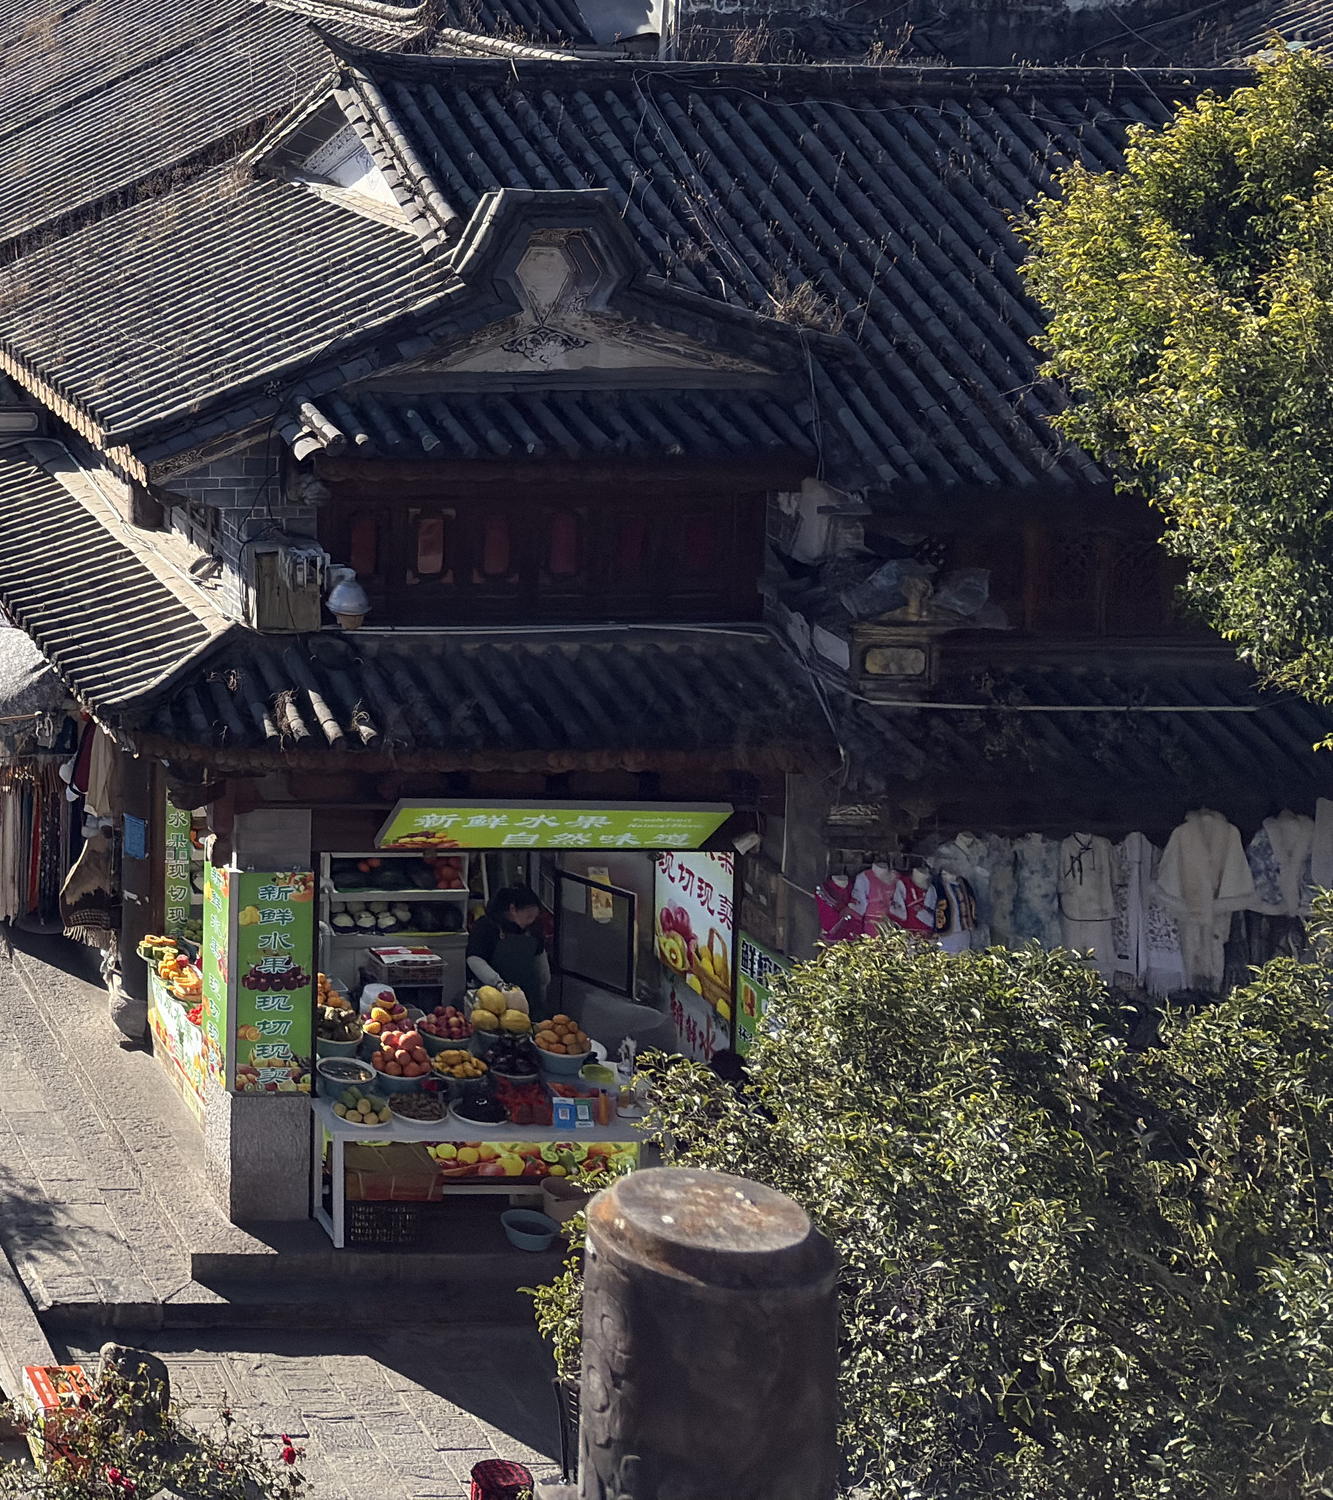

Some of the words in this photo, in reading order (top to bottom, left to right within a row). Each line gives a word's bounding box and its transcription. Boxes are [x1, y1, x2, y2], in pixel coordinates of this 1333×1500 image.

[413, 813, 612, 829] 新鲜水果
[501, 832, 690, 846] 自然味道
[658, 852, 733, 930] 现切现卖
[741, 938, 788, 991] 鲜榨
